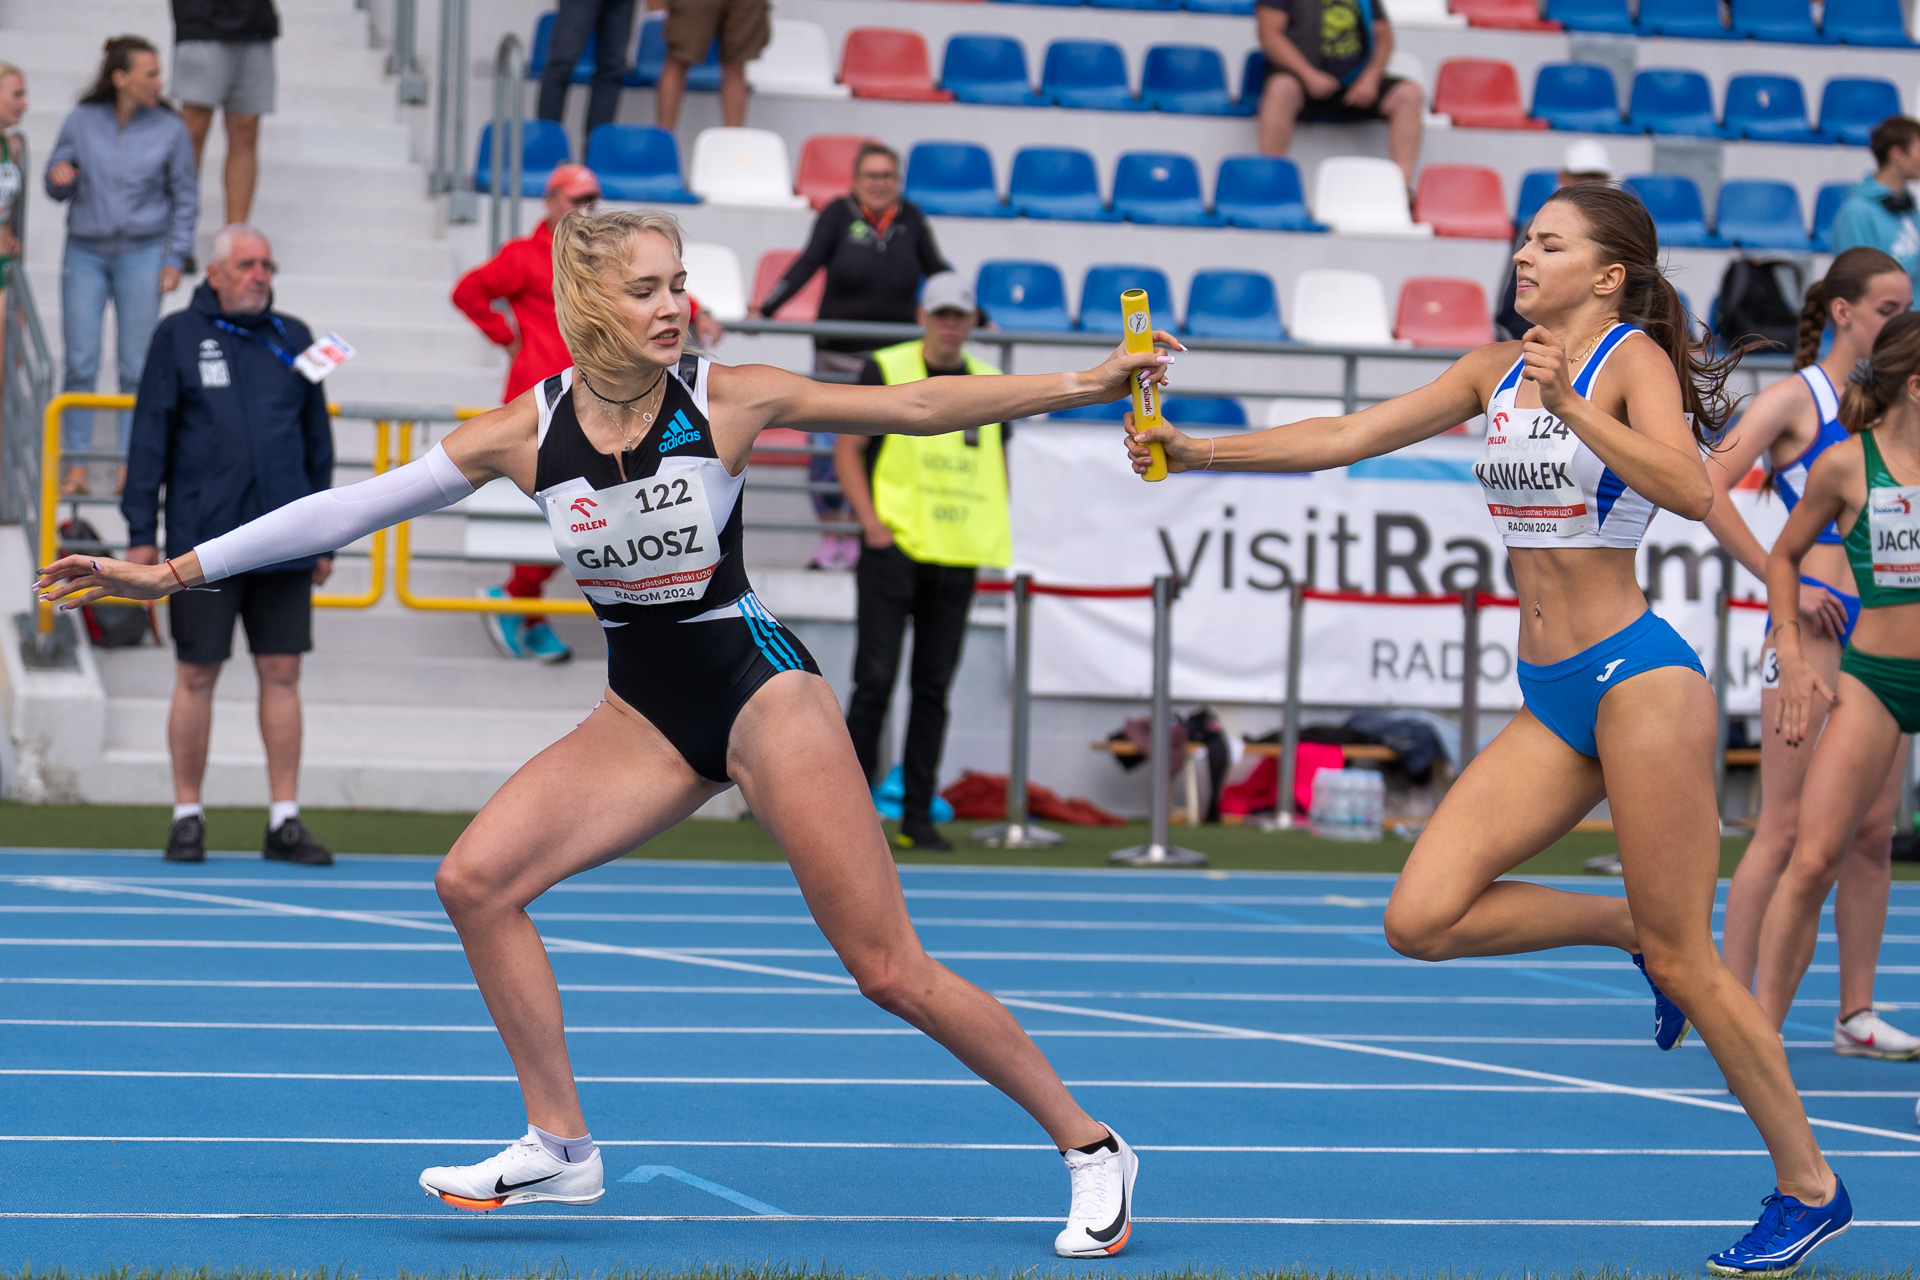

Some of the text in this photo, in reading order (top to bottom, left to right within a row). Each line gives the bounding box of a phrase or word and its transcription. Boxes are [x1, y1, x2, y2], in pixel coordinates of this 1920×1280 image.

[1143, 386, 1153, 415] olanik.
[1528, 415, 1570, 440] 124
[659, 429, 701, 453] adidas
[1475, 462, 1575, 491] KAWAŁEK
[634, 478, 692, 514] 122
[570, 518, 607, 533] ORLEN
[1508, 522, 1557, 533] RADOM 2024
[576, 525, 704, 570] GAJOSZ
[671, 573, 695, 583] Polski
[696, 568, 712, 580] U20
[615, 587, 695, 602] RADOM 2024
